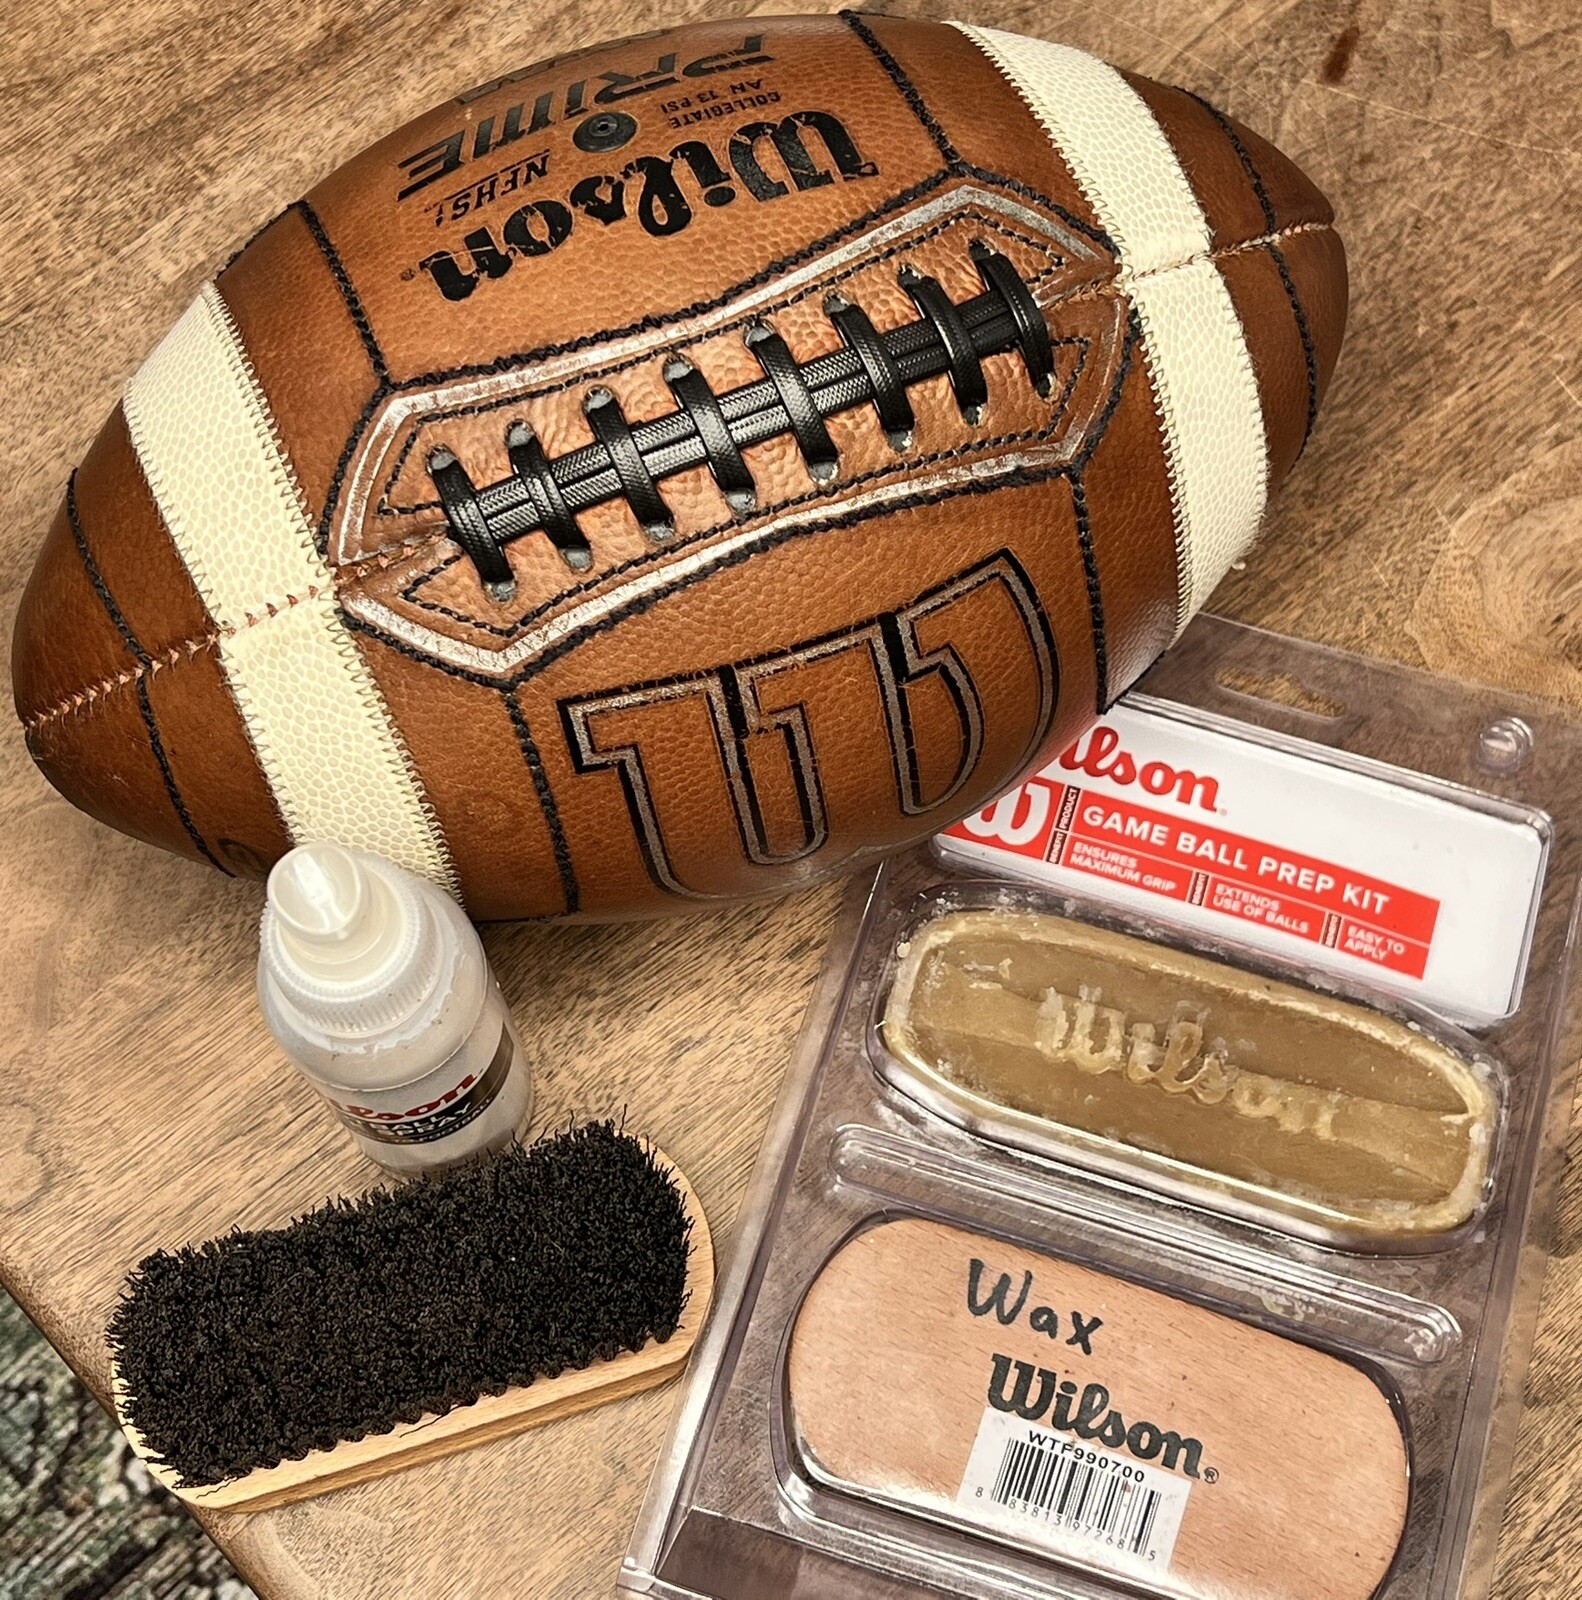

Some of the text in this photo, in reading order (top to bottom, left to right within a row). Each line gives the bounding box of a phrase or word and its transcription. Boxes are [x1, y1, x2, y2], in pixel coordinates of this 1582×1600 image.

[397, 34, 774, 201] PRIME
[661, 95, 692, 114] PSI
[668, 91, 781, 130] COLLEGIATE
[695, 89, 720, 106] 13
[418, 110, 879, 301] Wilson
[451, 153, 550, 222] NFHS
[1059, 727, 1220, 814] ilson
[1059, 787, 1078, 831] PRODUCT
[1069, 853, 1177, 892] MAXIMUM GRIP
[1073, 841, 1138, 869] ENSURES
[1083, 805, 1391, 915] GAME BALL PREP KIT
[1212, 895, 1242, 913] USE
[1243, 904, 1265, 919] OF
[1265, 909, 1310, 935] BALLS
[1214, 883, 1281, 911] EXTENDS
[1343, 938, 1388, 962] APPLY
[1347, 924, 1384, 946] EASY
[1384, 939, 1406, 955] TO
[967, 1258, 1104, 1356] Wax
[988, 1353, 1204, 1480] Wilson
[1028, 1429, 1146, 1484] WTF990700
[1008, 1498, 1063, 1528] 83813
[1071, 1519, 1126, 1551] 97268
